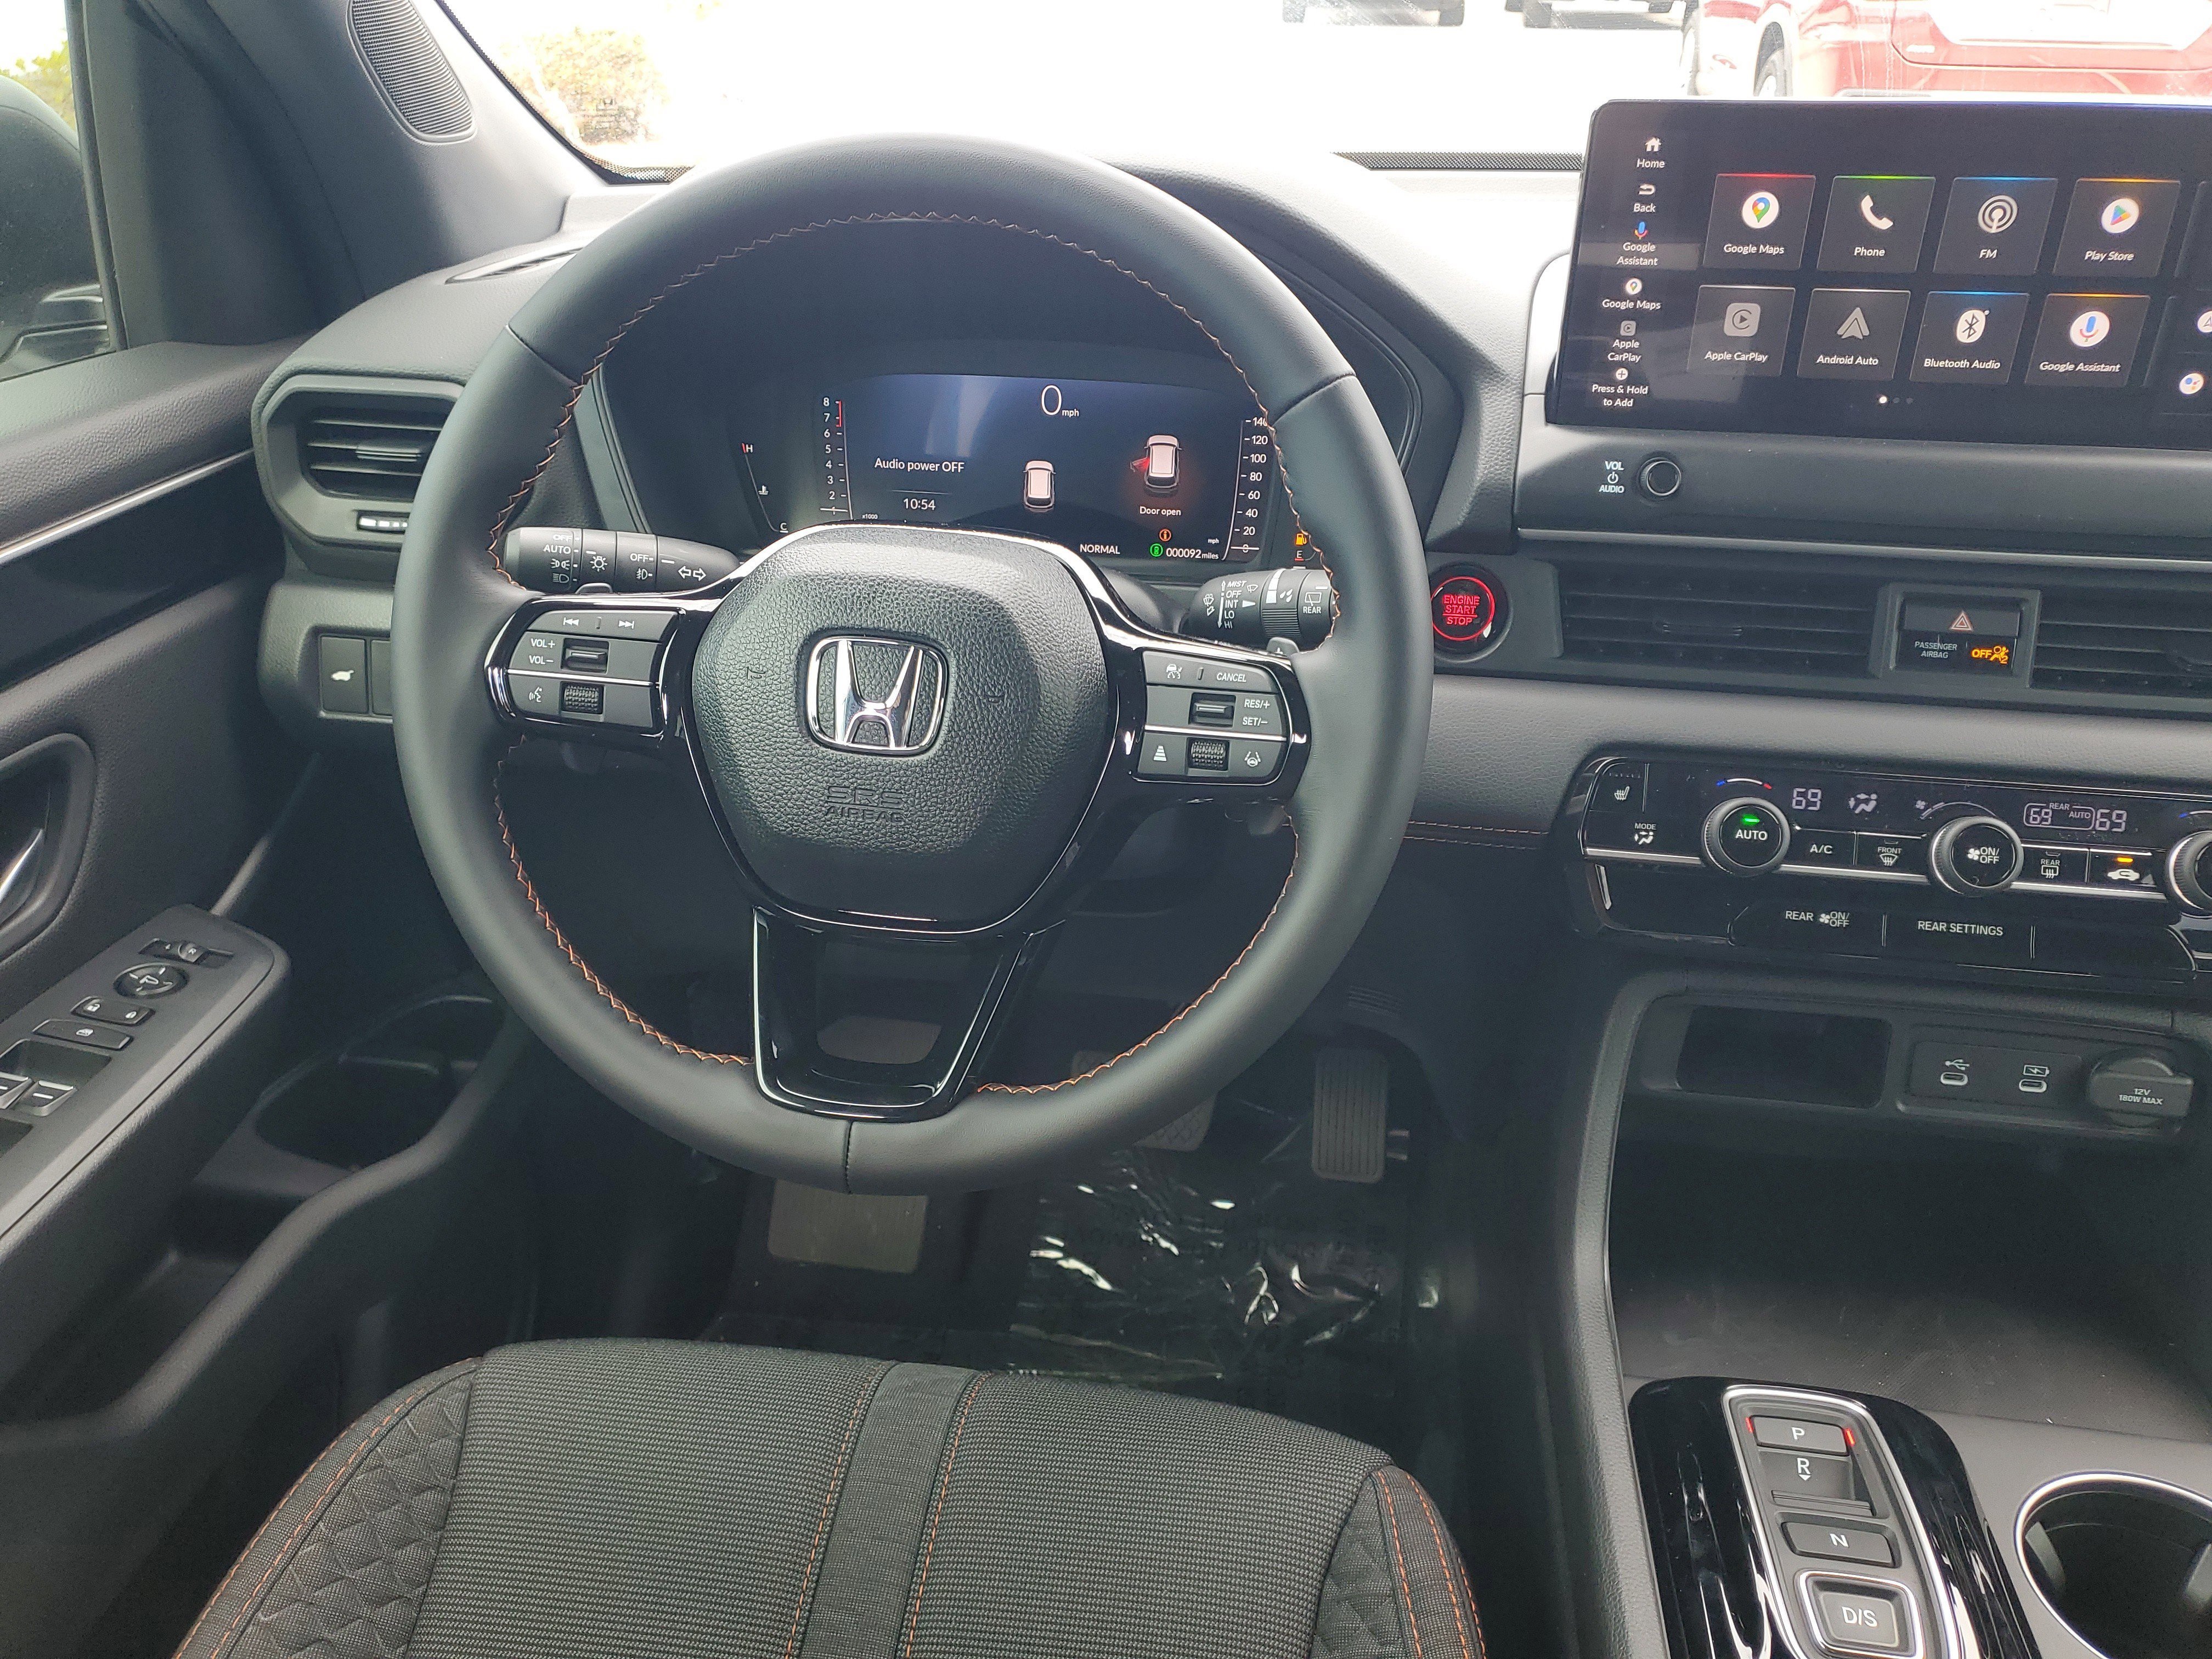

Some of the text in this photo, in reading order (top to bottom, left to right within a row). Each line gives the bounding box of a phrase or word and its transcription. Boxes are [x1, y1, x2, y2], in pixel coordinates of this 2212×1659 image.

[1637, 159, 1665, 169] Home
[1634, 203, 1656, 213] Back
[1623, 242, 1656, 253] Google
[1724, 244, 1785, 255] Google Maps
[1854, 247, 1885, 257] Phone
[1979, 249, 1997, 259] FM
[2085, 251, 2134, 262] Play Store
[1616, 257, 1658, 266] Assistant
[1602, 300, 1661, 311] Google Maps
[1613, 340, 1639, 349] Apple
[1608, 353, 1641, 363] CarPlay
[1705, 352, 1768, 363] Apple CarPlay
[1816, 355, 1878, 365] Android Auto
[1924, 359, 2000, 369] Bluetooth Audio
[2040, 362, 2121, 373] Google Assistant
[1592, 385, 1648, 394] Press & Hold
[823, 397, 830, 407] 8
[1041, 385, 1080, 417] 0 mph
[1614, 398, 1633, 407] Add
[823, 413, 830, 423] 7
[824, 429, 830, 438] 6
[1252, 435, 1268, 444] 120
[746, 444, 753, 453] H
[825, 444, 831, 454] 5
[1250, 453, 1267, 464] 100
[825, 460, 832, 470] 4
[874, 458, 964, 473] Audio power OFF
[1605, 461, 1624, 471] VOL
[827, 476, 834, 485] 3
[1250, 472, 1262, 482] 80
[1599, 484, 1624, 493] AUDIO
[828, 491, 835, 500] 2
[1248, 490, 1260, 500] 60
[903, 498, 936, 510] 10:54
[1139, 506, 1181, 518] Door open
[1245, 508, 1258, 518] 40
[780, 522, 787, 531] C
[1243, 526, 1255, 535] 20
[543, 544, 571, 555] AUTO
[1080, 544, 1120, 555] NORMAL
[1166, 548, 1219, 560] 000092 miles
[1296, 550, 1302, 559] E
[630, 553, 648, 562] OFF
[1224, 600, 1238, 608] INT
[1443, 595, 1480, 605] ENGINE
[1224, 610, 1235, 619] LO
[1445, 605, 1476, 615] START
[1224, 620, 1233, 629] HI
[1446, 616, 1472, 625] STOP
[1915, 641, 1957, 651] PASSENGER
[1971, 648, 1993, 658] OFF
[1216, 673, 1247, 682] CANCEL
[827, 786, 905, 807] SRS
[1792, 787, 1822, 811] 69
[2049, 802, 2070, 810] REAR
[2069, 811, 2091, 819] AUTO
[2095, 809, 2127, 832] 69
[1735, 830, 1768, 841] AUTO
[1810, 844, 1833, 855] A/C
[1980, 847, 2000, 855] ON/
[1979, 855, 2000, 865] OFF
[1785, 911, 1850, 922] REAR ON/
[1830, 919, 1849, 928] OFF
[1917, 921, 2003, 936] REAR SETTINGS
[2119, 1094, 2141, 1103] 180W
[1792, 1427, 1805, 1440] P
[1797, 1458, 1810, 1474] R
[1830, 1533, 1848, 1547] N
[1842, 1606, 1877, 1627] D/S
